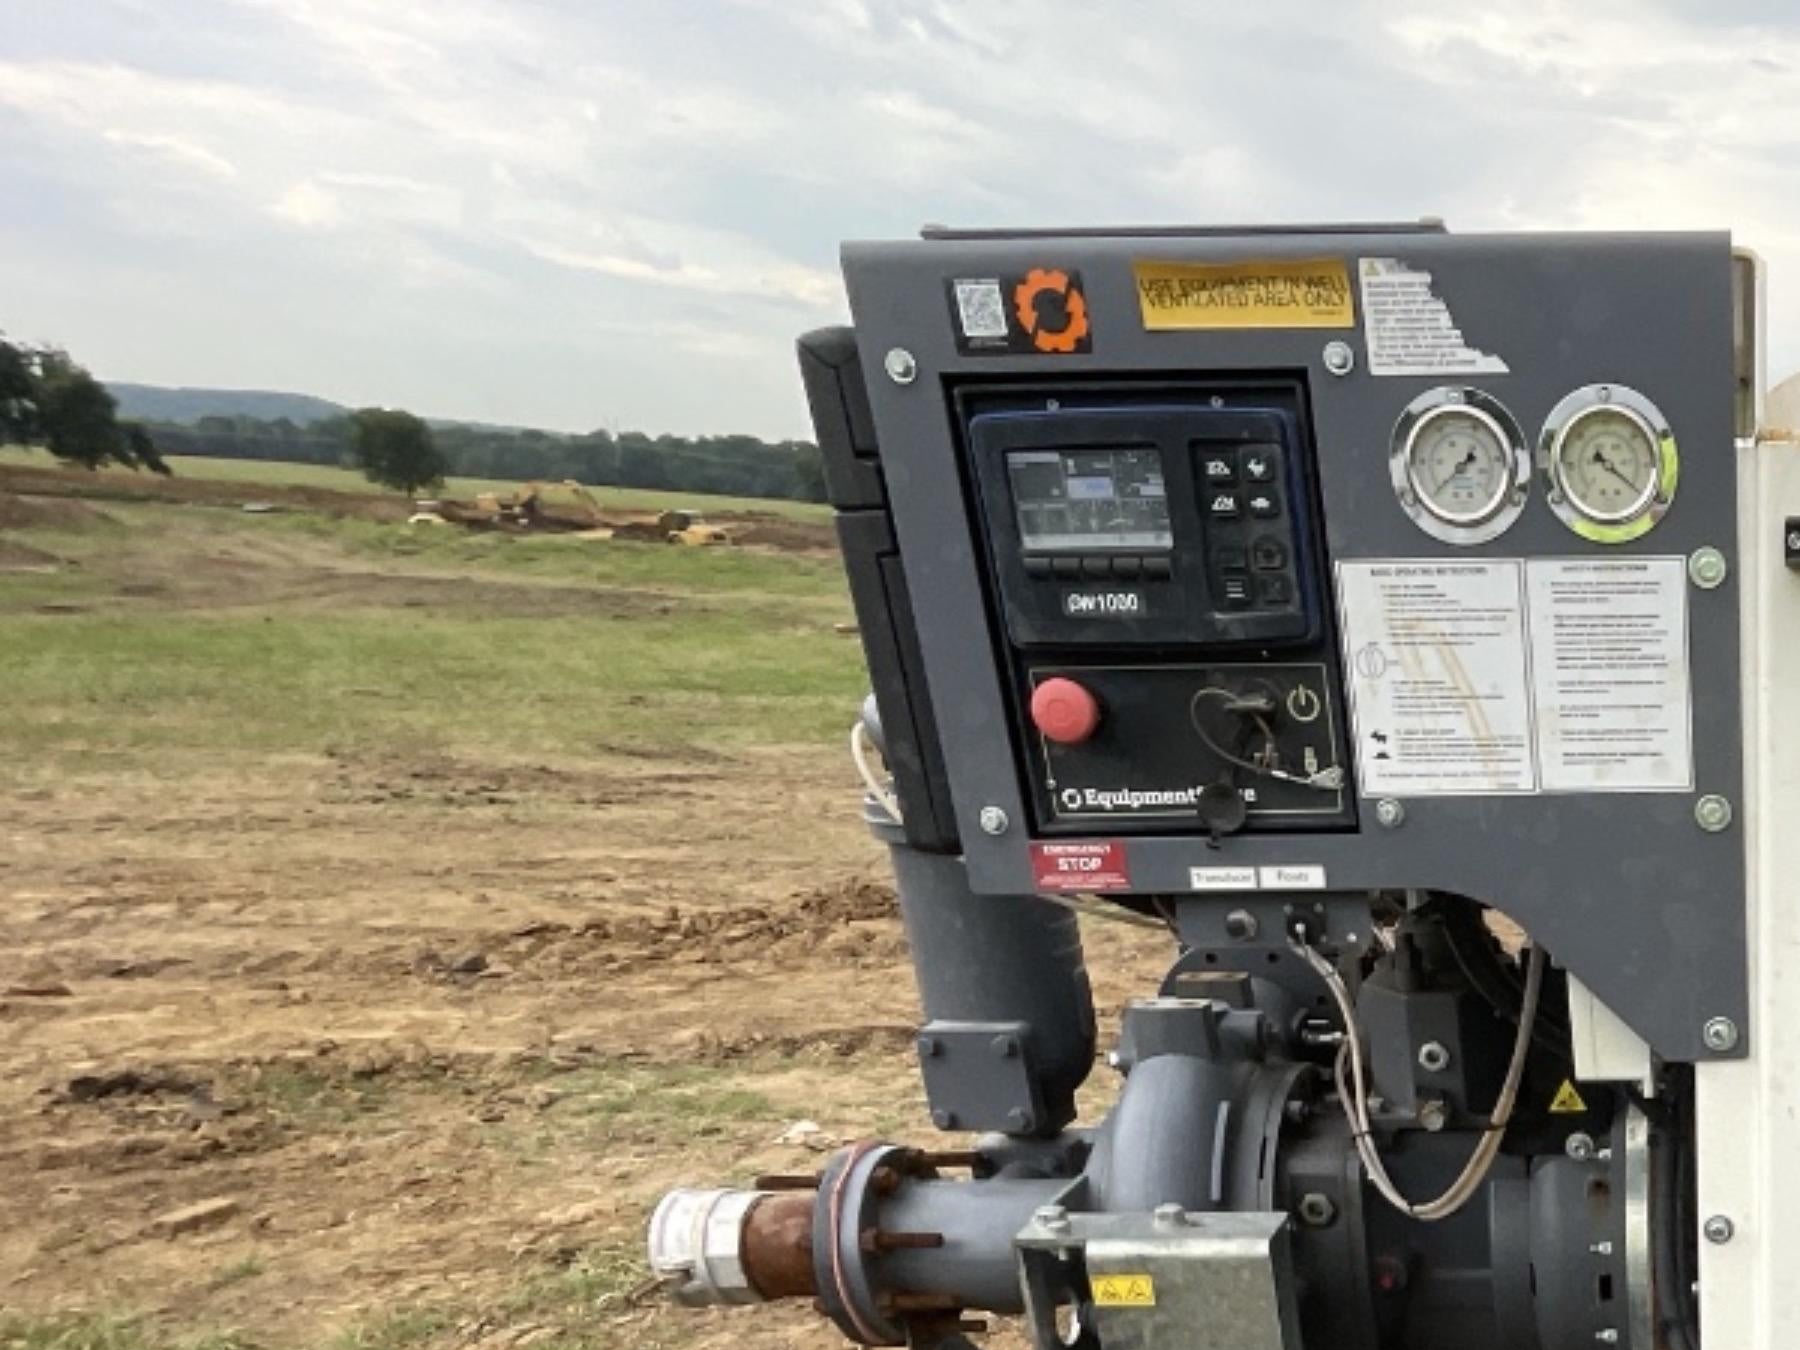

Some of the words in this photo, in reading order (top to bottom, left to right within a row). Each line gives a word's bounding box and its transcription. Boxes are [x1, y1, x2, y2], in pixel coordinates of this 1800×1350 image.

[1144, 290, 1249, 308] VENTILATED
[1253, 290, 1300, 307] AREA
[1304, 289, 1346, 307] ONLY
[1058, 857, 1102, 871] STOP
